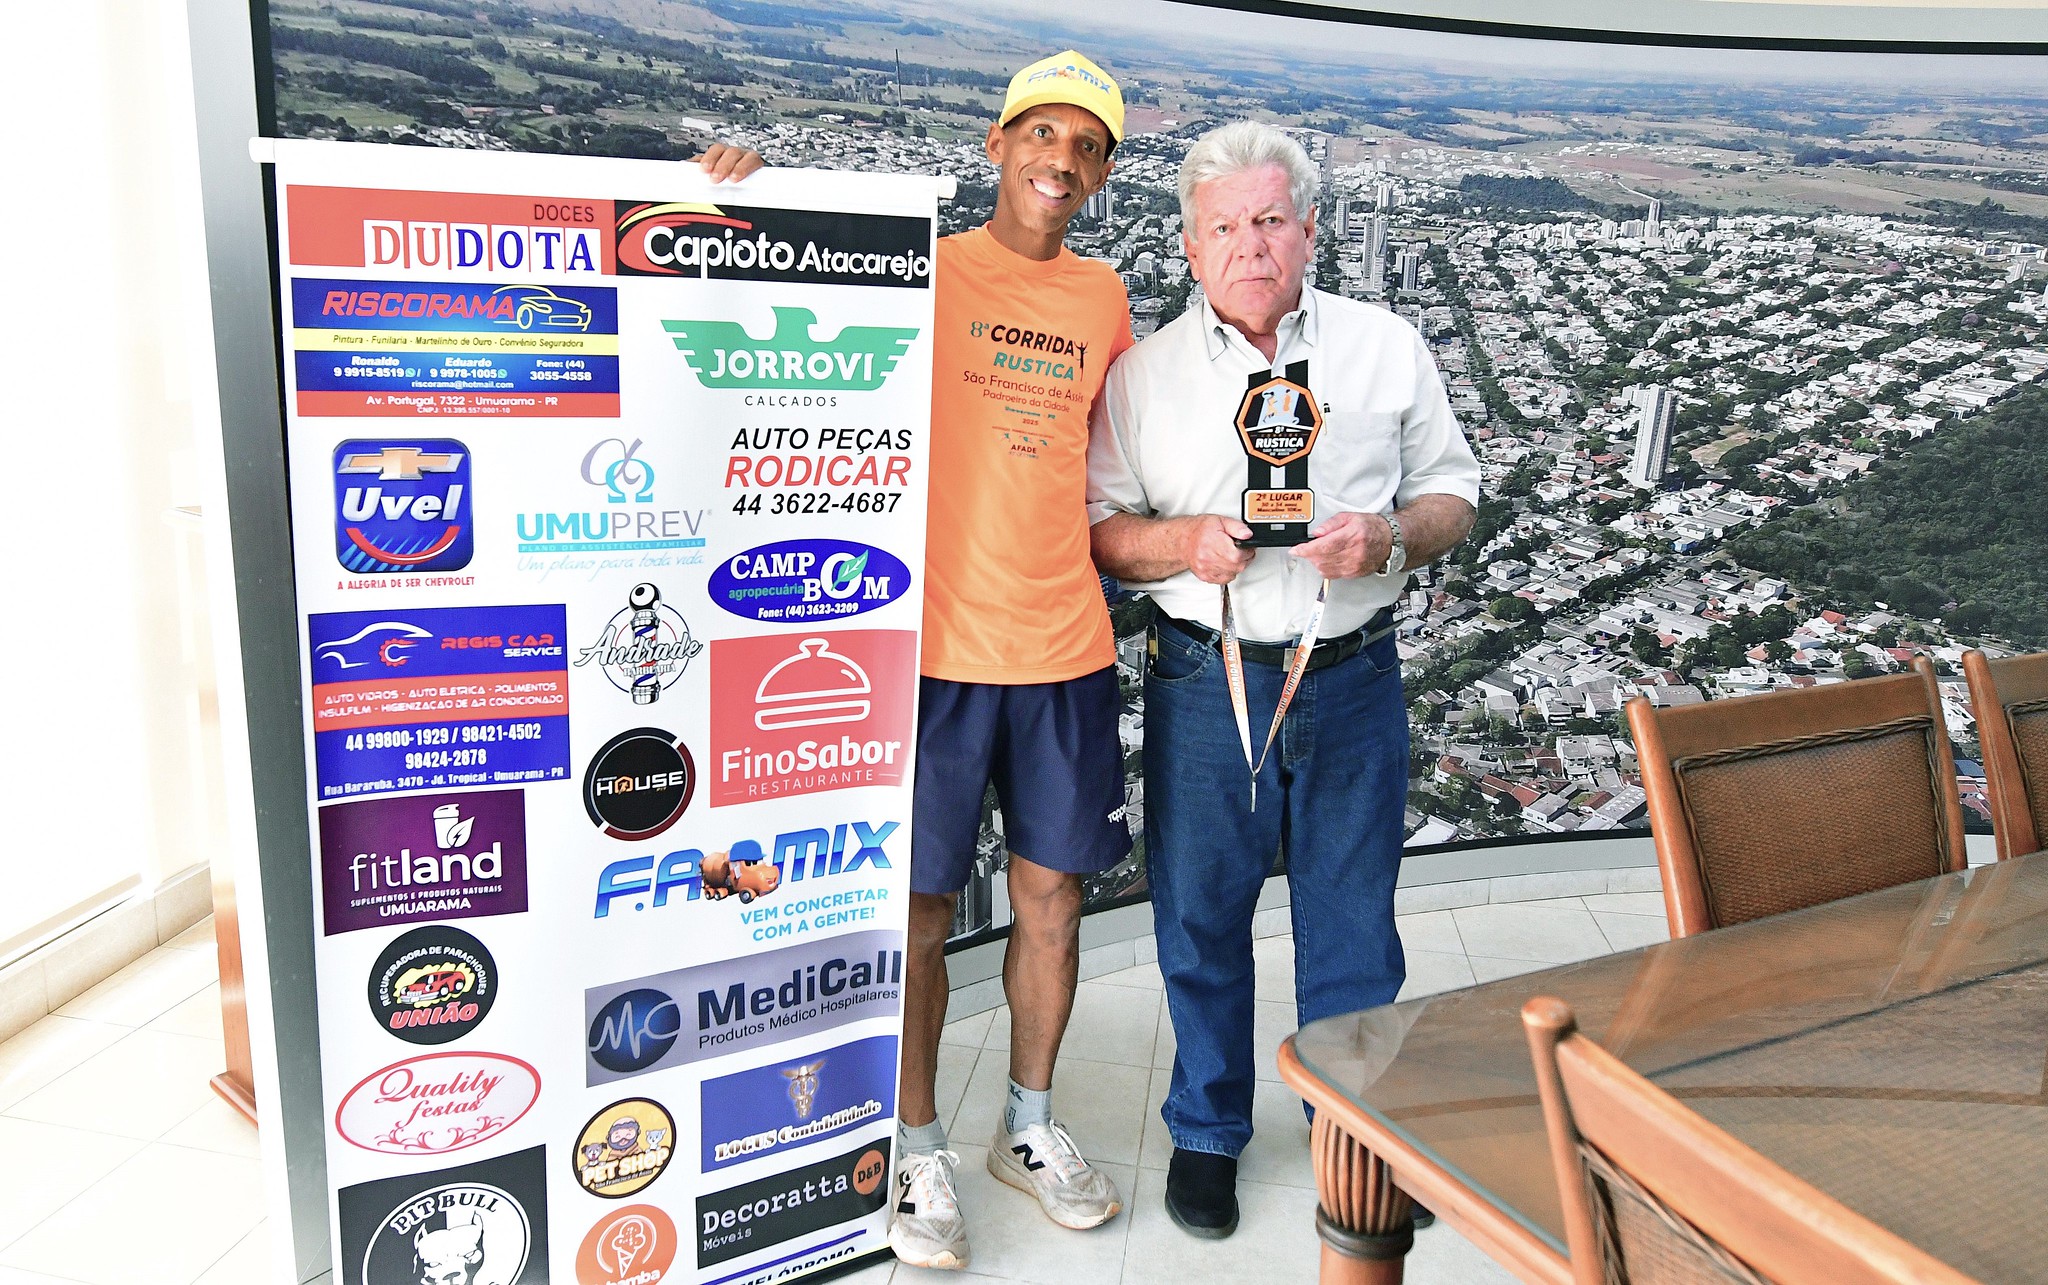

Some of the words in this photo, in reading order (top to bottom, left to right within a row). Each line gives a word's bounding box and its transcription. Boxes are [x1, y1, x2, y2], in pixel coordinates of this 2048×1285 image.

[534, 204, 594, 223] DOCES
[372, 225, 596, 272] DUDOTA
[643, 225, 795, 278] Capioto
[796, 241, 930, 281] Atacarejo
[322, 290, 515, 320] RISCORAMA
[333, 335, 363, 343] Pintura
[371, 336, 407, 344] Funilaria
[416, 337, 458, 345] Martelinho
[473, 338, 492, 346] Ouro
[500, 338, 536, 346] Convênio
[540, 338, 583, 349] Seguradora
[991, 324, 1074, 356] CORRIDA
[334, 367, 342, 376] 9
[344, 368, 404, 377] 9915-8519
[352, 356, 400, 366] Ronaldo
[430, 369, 438, 377] 9
[445, 357, 492, 367] Eduardo
[566, 360, 585, 368] (44)
[709, 349, 874, 381] JORROVI
[993, 352, 1074, 381] RUSTICA
[412, 380, 514, 390] riscorama@hotmail.com
[530, 371, 592, 381] 3055-4558
[963, 371, 986, 385] São
[990, 375, 1045, 395] Francisco
[1049, 386, 1062, 398] de
[1065, 389, 1084, 403] Assis
[366, 396, 384, 405] Av.
[388, 396, 436, 406] Portugal,
[440, 396, 465, 405] 7322
[476, 397, 535, 405] Umuarama
[545, 397, 558, 405] PR
[745, 396, 838, 407] CALÇADOS
[983, 389, 1027, 405] Padroeiro
[1029, 398, 1041, 407] da
[1044, 400, 1070, 413] Cidade
[731, 428, 809, 450] AUTO
[818, 429, 912, 455] PEÇAS
[1011, 444, 1037, 454] AFADE
[1255, 438, 1304, 448] RUSTICA
[725, 455, 912, 488] RODICAR
[342, 484, 463, 522] Uvel
[732, 494, 762, 515] 44
[771, 493, 902, 514] 3622-4687
[517, 509, 704, 541] UMUPREV
[518, 556, 544, 571] Um
[677, 550, 704, 565] vida
[730, 552, 816, 580] CAMP
[337, 581, 343, 590] A
[348, 579, 387, 589] ALEGRIA
[391, 578, 401, 588] DE
[405, 578, 421, 587] SER
[425, 577, 475, 586] CHEVROLET
[728, 583, 804, 601] agropecuária
[758, 607, 783, 619] Fone:
[785, 604, 805, 617] (44)
[807, 602, 858, 615] 3623-3209
[441, 636, 502, 650] REGIS
[508, 634, 554, 647] CAR
[503, 647, 562, 658] SERVICE
[573, 624, 704, 667] Andrade
[325, 693, 354, 705] AUTO
[357, 690, 399, 701] VIDROS
[409, 687, 437, 698] AUTO
[439, 686, 485, 696] ELETRICA
[495, 682, 557, 693] POLIMENTOS
[1230, 666, 1243, 698] CORRIDA
[318, 706, 371, 718] INSULFILM
[455, 699, 468, 708] DE
[471, 699, 486, 707] AR
[489, 694, 564, 707] CONDICIONADO
[346, 734, 364, 751] 44
[366, 728, 449, 749] 99800-1929
[462, 723, 541, 743] 98421-4502
[722, 736, 901, 782] FinoSabor
[324, 785, 343, 796] Rua
[431, 775, 446, 785] Jd.
[448, 772, 486, 784] Tropical
[494, 769, 544, 781] Umuarama
[551, 767, 563, 777] PR
[749, 769, 874, 796] RESTAURANTE
[348, 842, 502, 891] fitland
[351, 893, 408, 907] SUPLEMENTOS
[418, 888, 460, 899] PRODUTOS
[463, 885, 502, 894] NATURAIS
[380, 897, 471, 917] UMUARAMA
[740, 907, 778, 924] VEM
[784, 888, 889, 917] CONCRETAR
[753, 923, 792, 941] COM
[797, 920, 809, 932] A
[814, 906, 875, 929] GENTE!
[380, 948, 428, 1006] RECUPERADORA
[429, 946, 442, 954] DE
[444, 947, 487, 995] PARACHOQUES
[698, 950, 901, 1031] MediCall
[390, 1001, 479, 1029] UNIÃO
[698, 1023, 765, 1049] Produtos
[769, 1008, 816, 1030] Médico
[820, 989, 898, 1015] Hospitalares
[374, 1068, 504, 1104] Quality
[395, 1100, 484, 1128] festas
[715, 1129, 777, 1161] LOCUS
[778, 1099, 881, 1143] Contabilidade
[582, 1160, 619, 1186] PET
[619, 1148, 670, 1176] SHOP
[394, 1201, 431, 1231] PIT
[441, 1193, 499, 1213] BULL
[703, 1174, 848, 1234] Decoratta
[857, 1162, 881, 1184] D&B
[703, 1226, 752, 1252] Móveis
